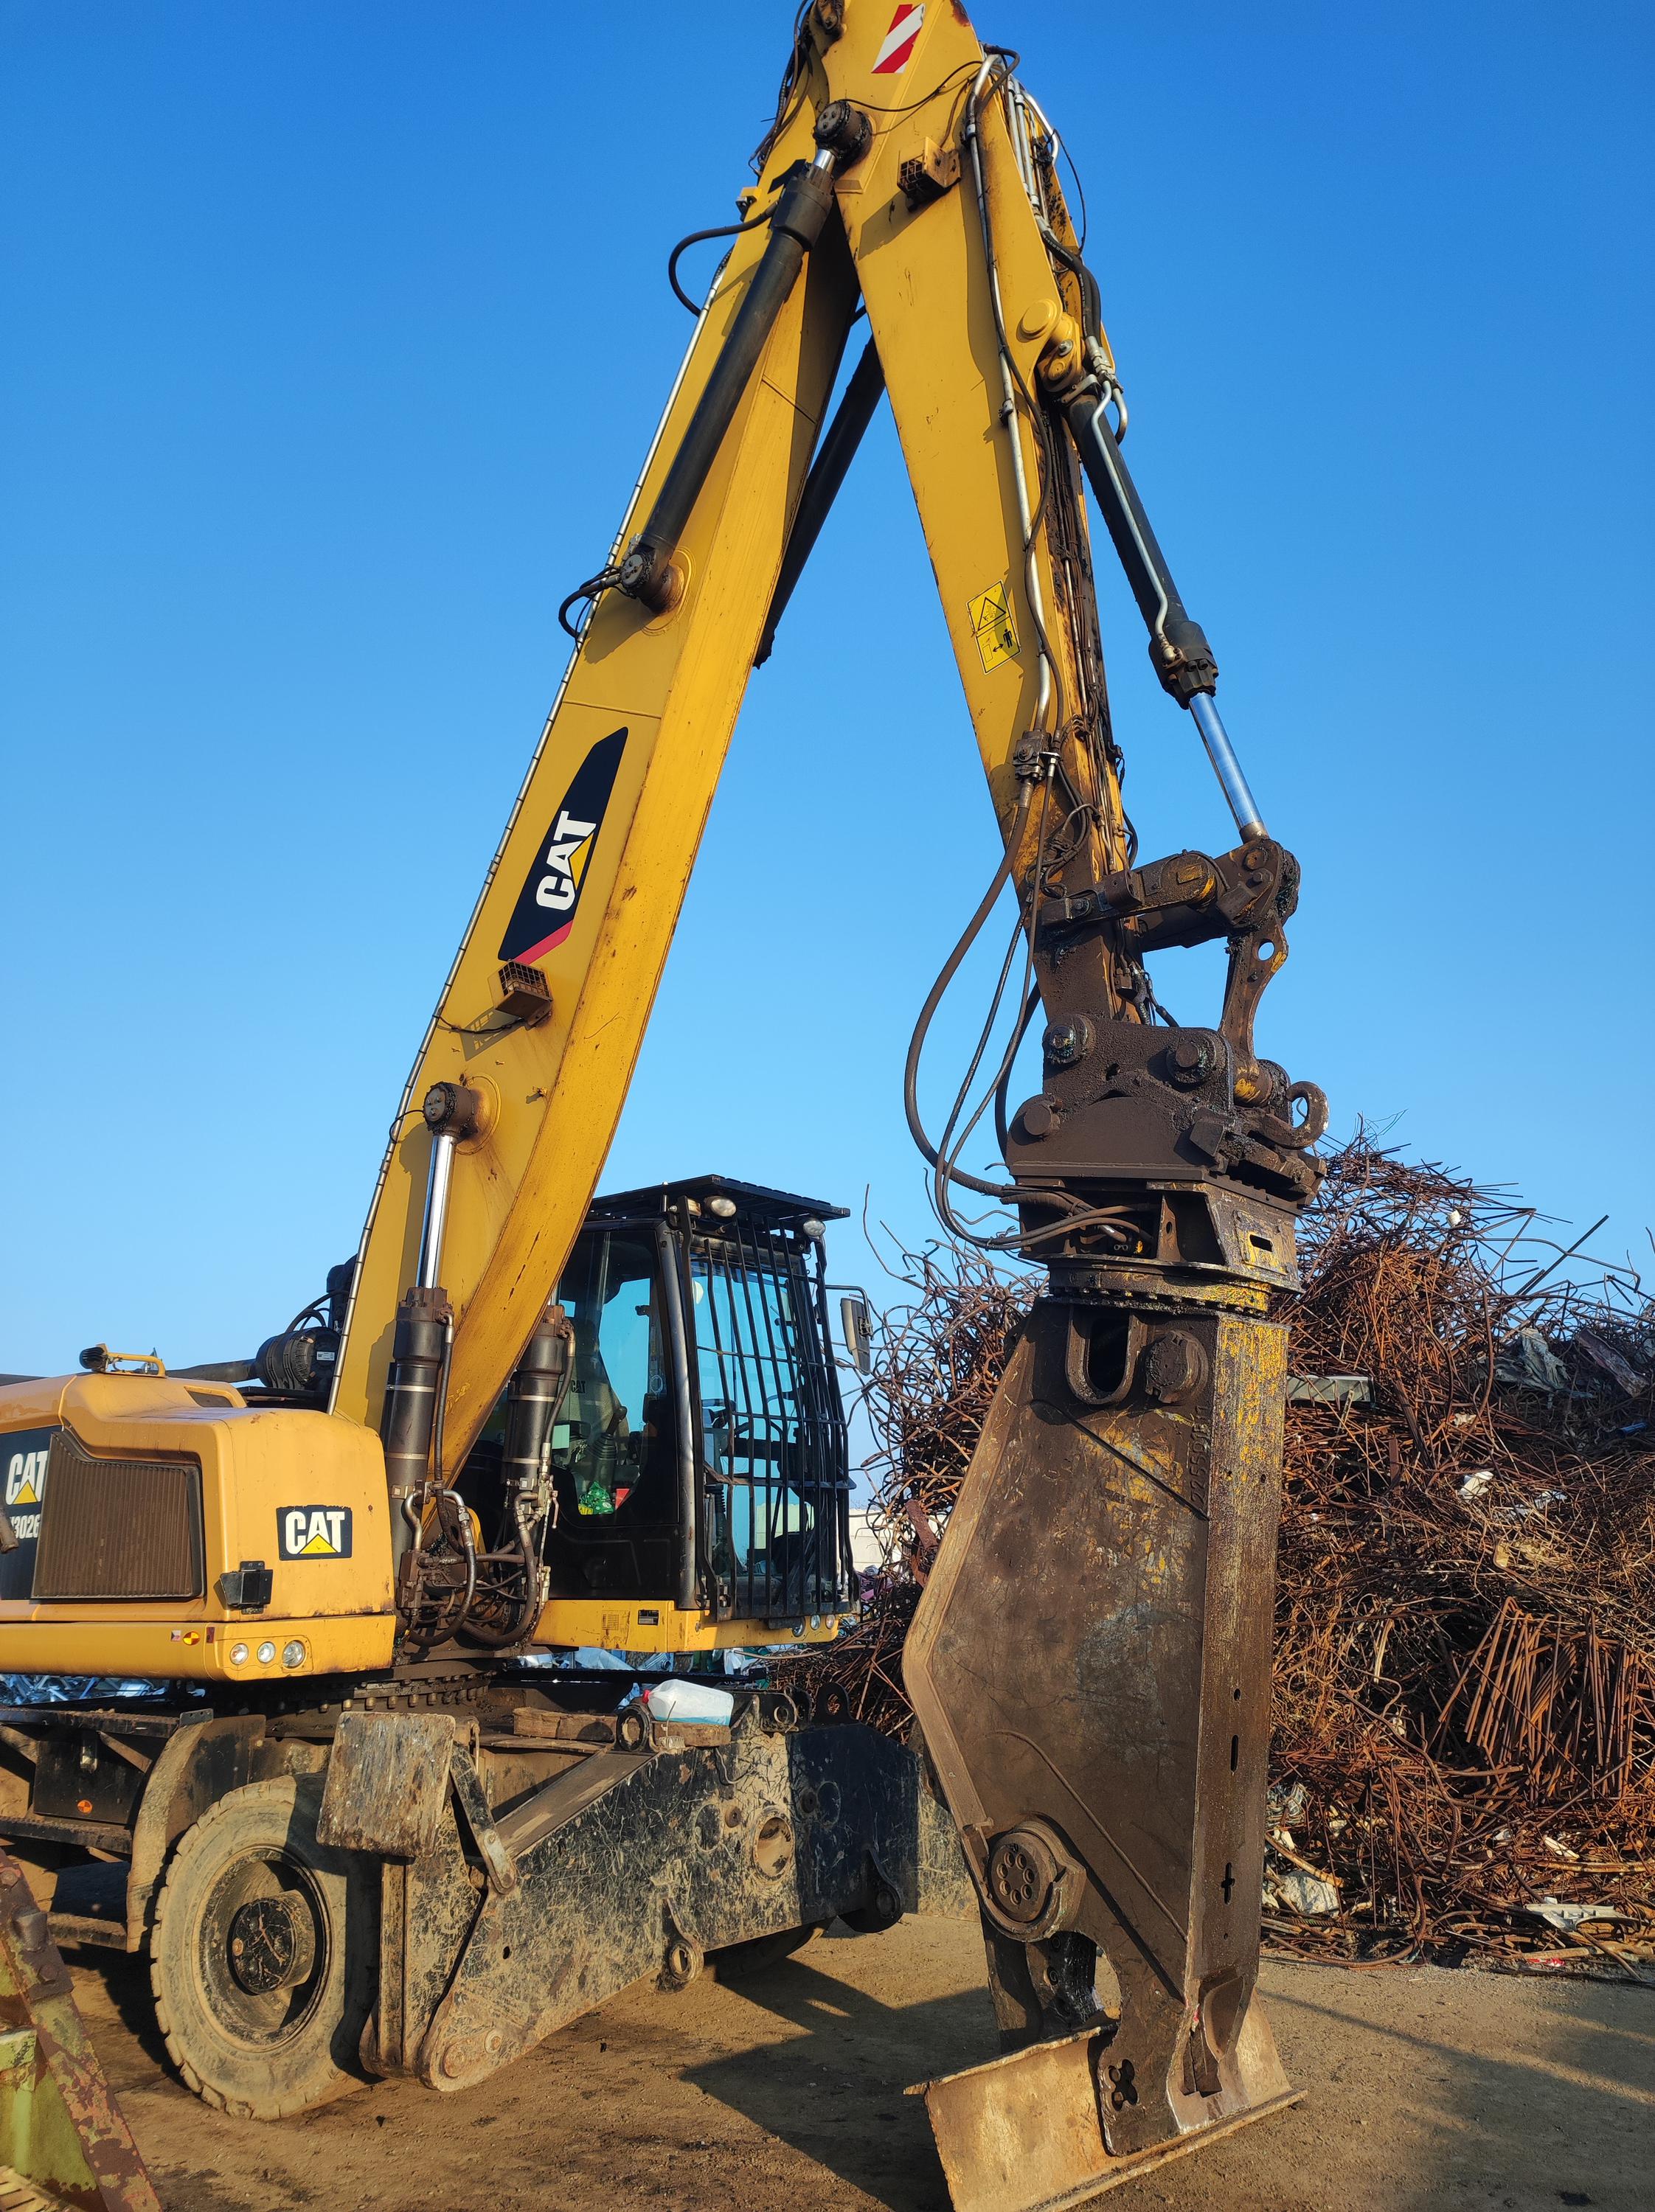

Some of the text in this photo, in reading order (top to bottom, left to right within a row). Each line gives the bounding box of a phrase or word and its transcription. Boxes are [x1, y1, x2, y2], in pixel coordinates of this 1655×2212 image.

[537, 810, 597, 911] CAT
[571, 1380, 586, 1393] CAT
[5, 1450, 49, 1505] CAT
[285, 1511, 345, 1554] CAT
